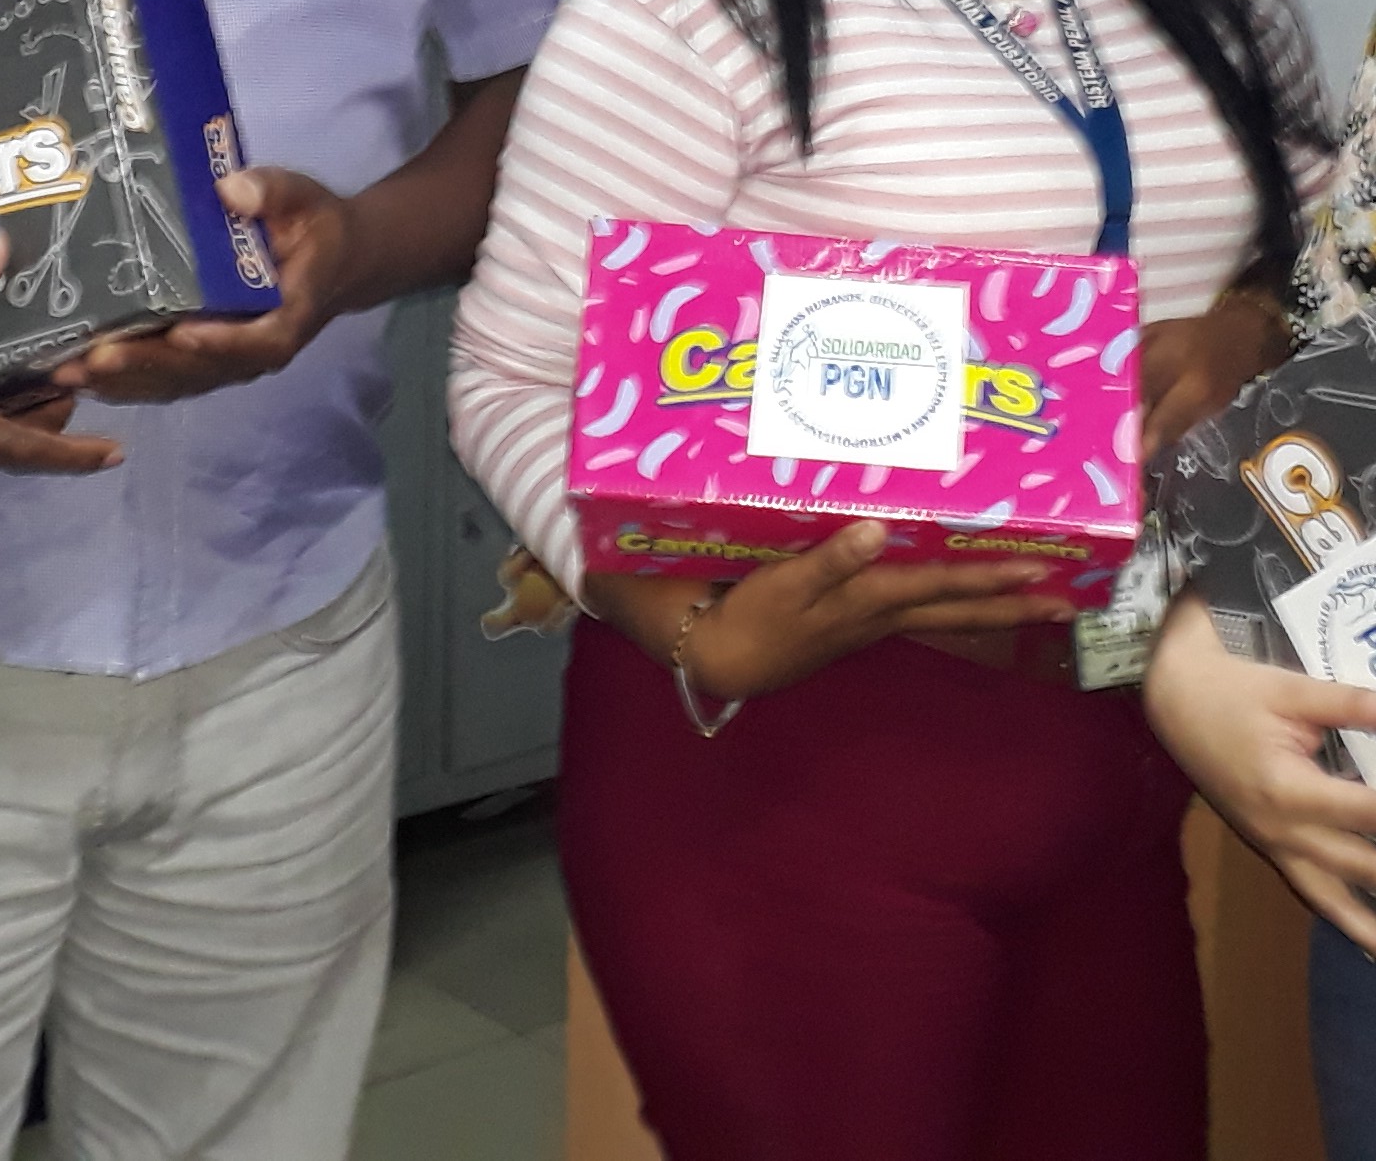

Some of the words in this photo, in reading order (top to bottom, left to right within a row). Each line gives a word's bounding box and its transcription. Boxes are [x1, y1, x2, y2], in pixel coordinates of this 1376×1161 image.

[1058, 6, 1088, 49] PENAL
[979, 24, 1063, 104] ACUSATORIO
[1073, 47, 1111, 109] SISTEMA
[659, 328, 1045, 416] Cars
[820, 338, 922, 361] SOLIDARIDAD
[819, 363, 896, 401] PGN
